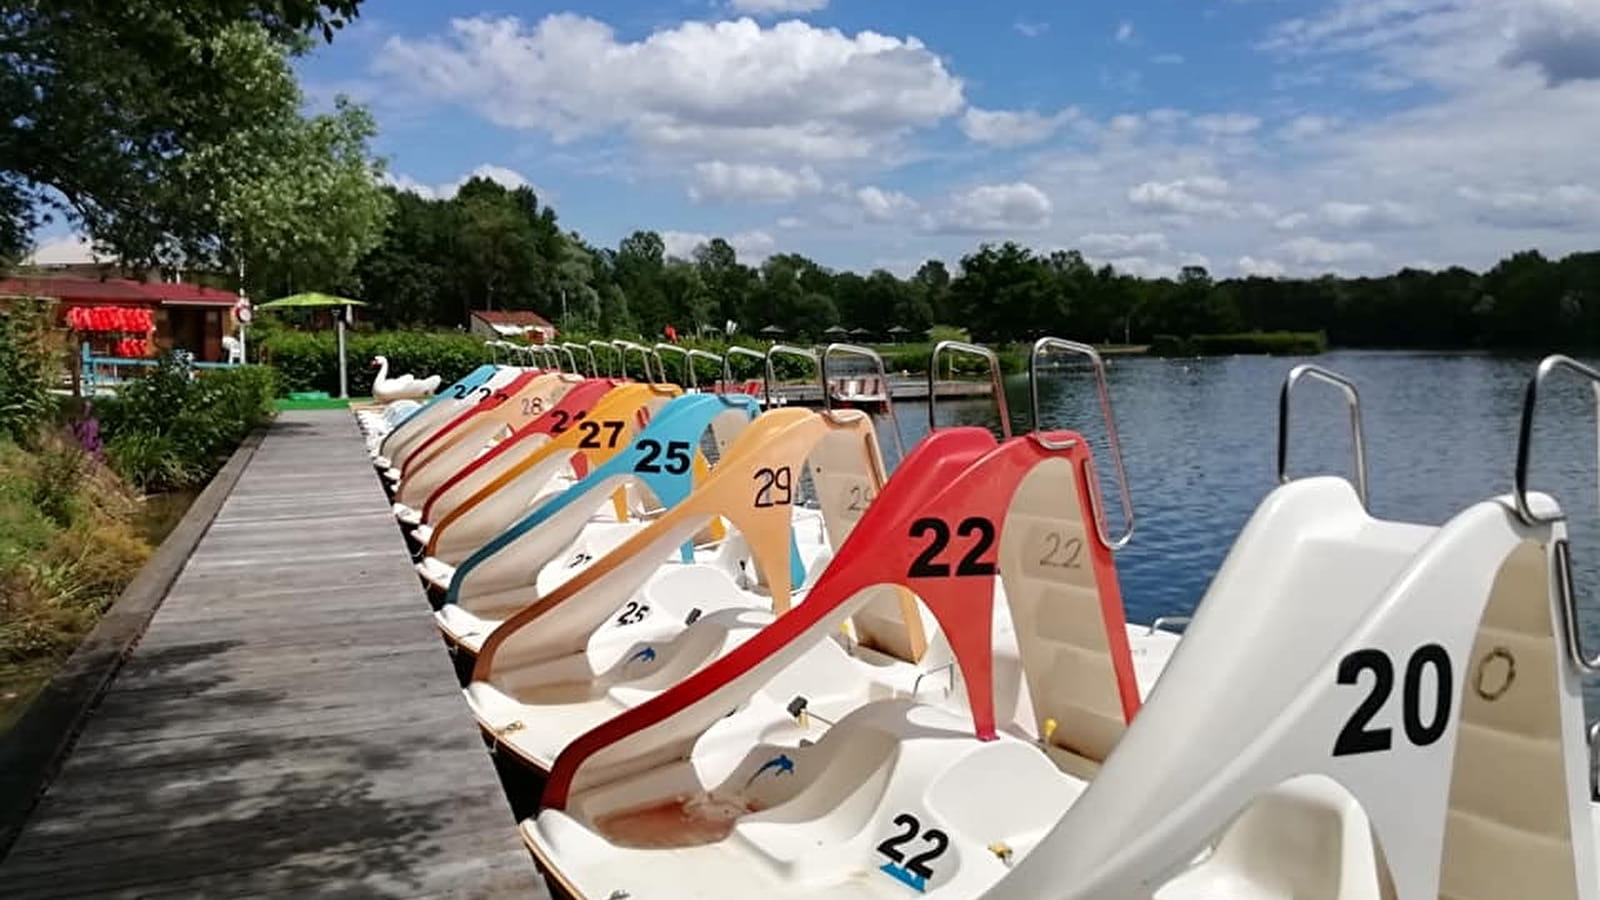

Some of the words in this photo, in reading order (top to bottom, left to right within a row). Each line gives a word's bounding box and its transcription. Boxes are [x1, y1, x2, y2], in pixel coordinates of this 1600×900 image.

[578, 421, 625, 448] 27
[634, 440, 690, 474] 25
[753, 466, 791, 507] 29
[907, 517, 997, 578] 22
[1040, 533, 1083, 568] 22
[616, 602, 649, 627] 25
[1333, 644, 1453, 756] 20
[877, 814, 949, 879] 22
